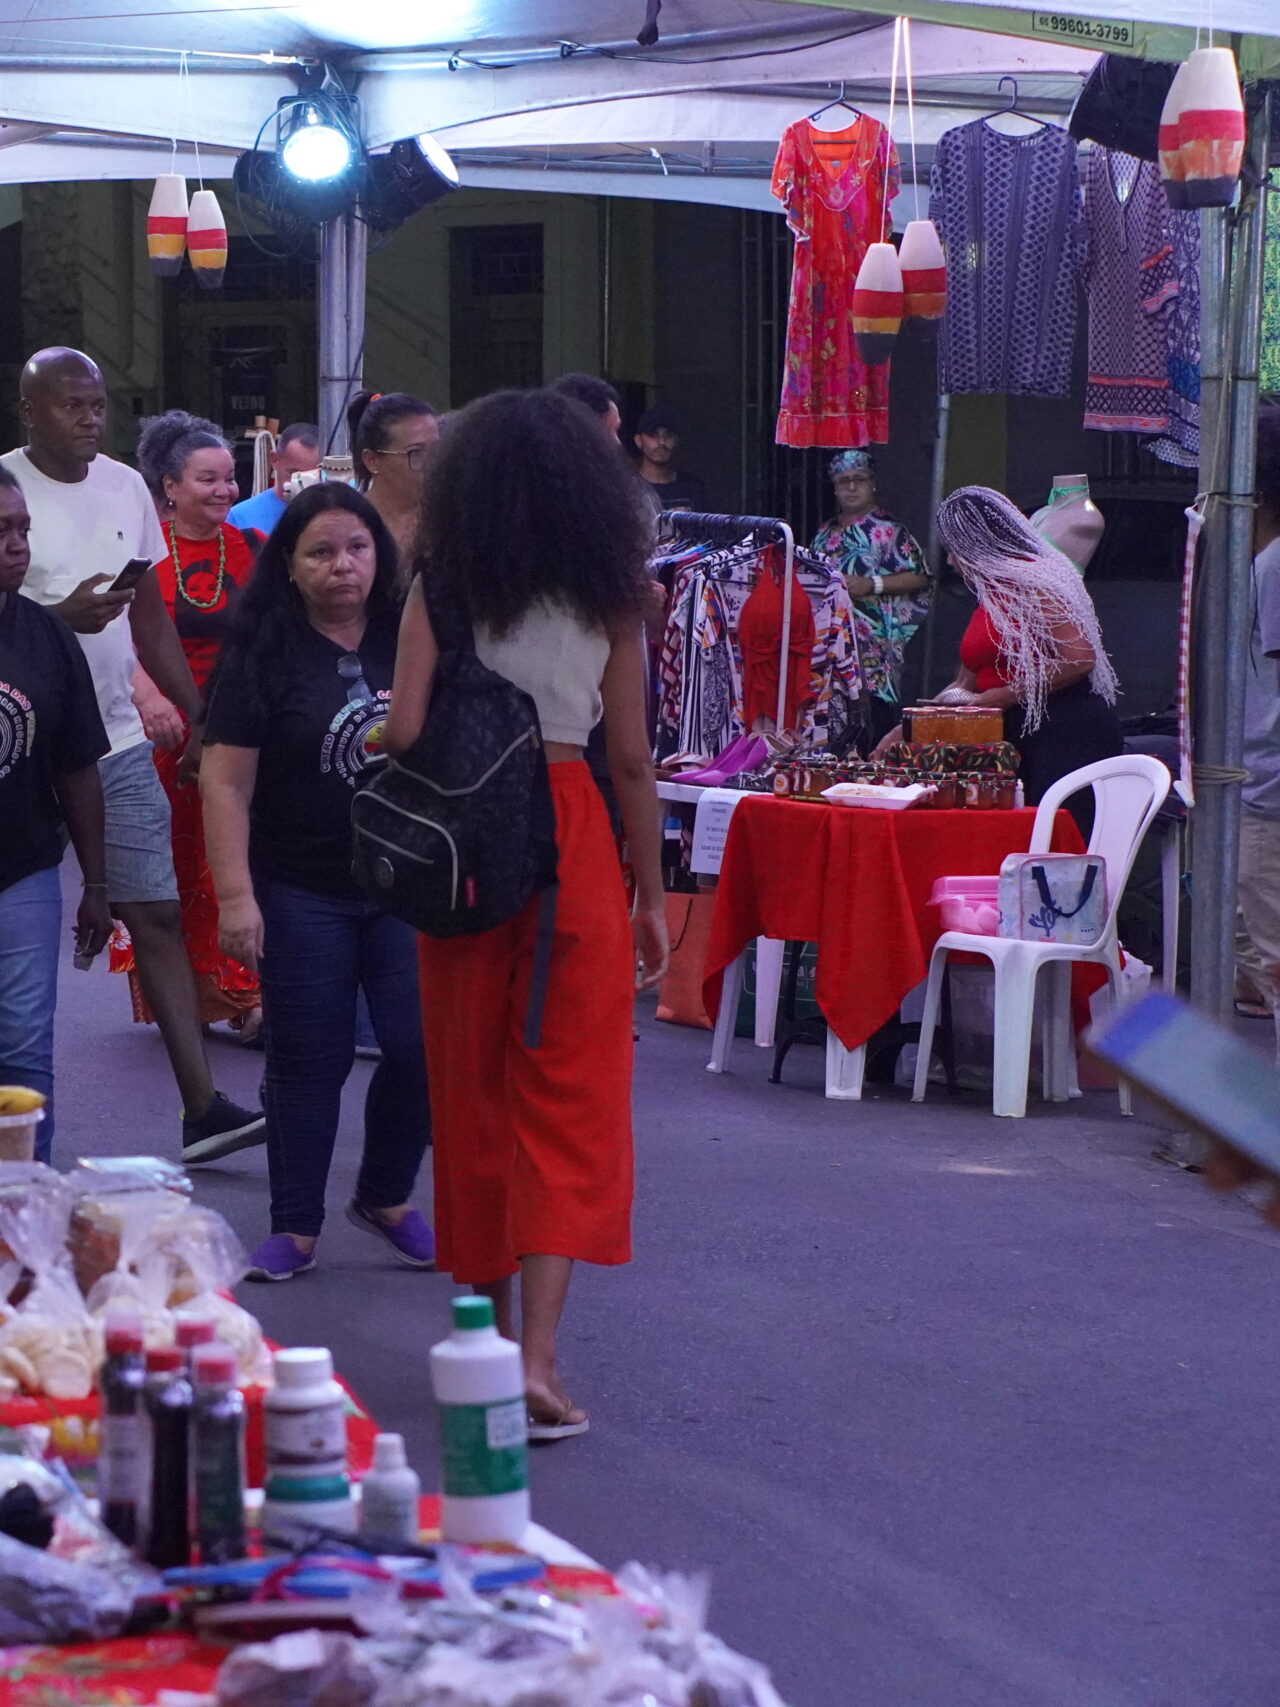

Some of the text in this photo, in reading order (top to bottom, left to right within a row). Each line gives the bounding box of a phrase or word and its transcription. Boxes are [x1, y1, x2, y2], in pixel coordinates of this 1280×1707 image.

[1051, 15, 1129, 42] 99601-3799
[10, 688, 31, 711] DAS
[377, 690, 392, 700] CA
